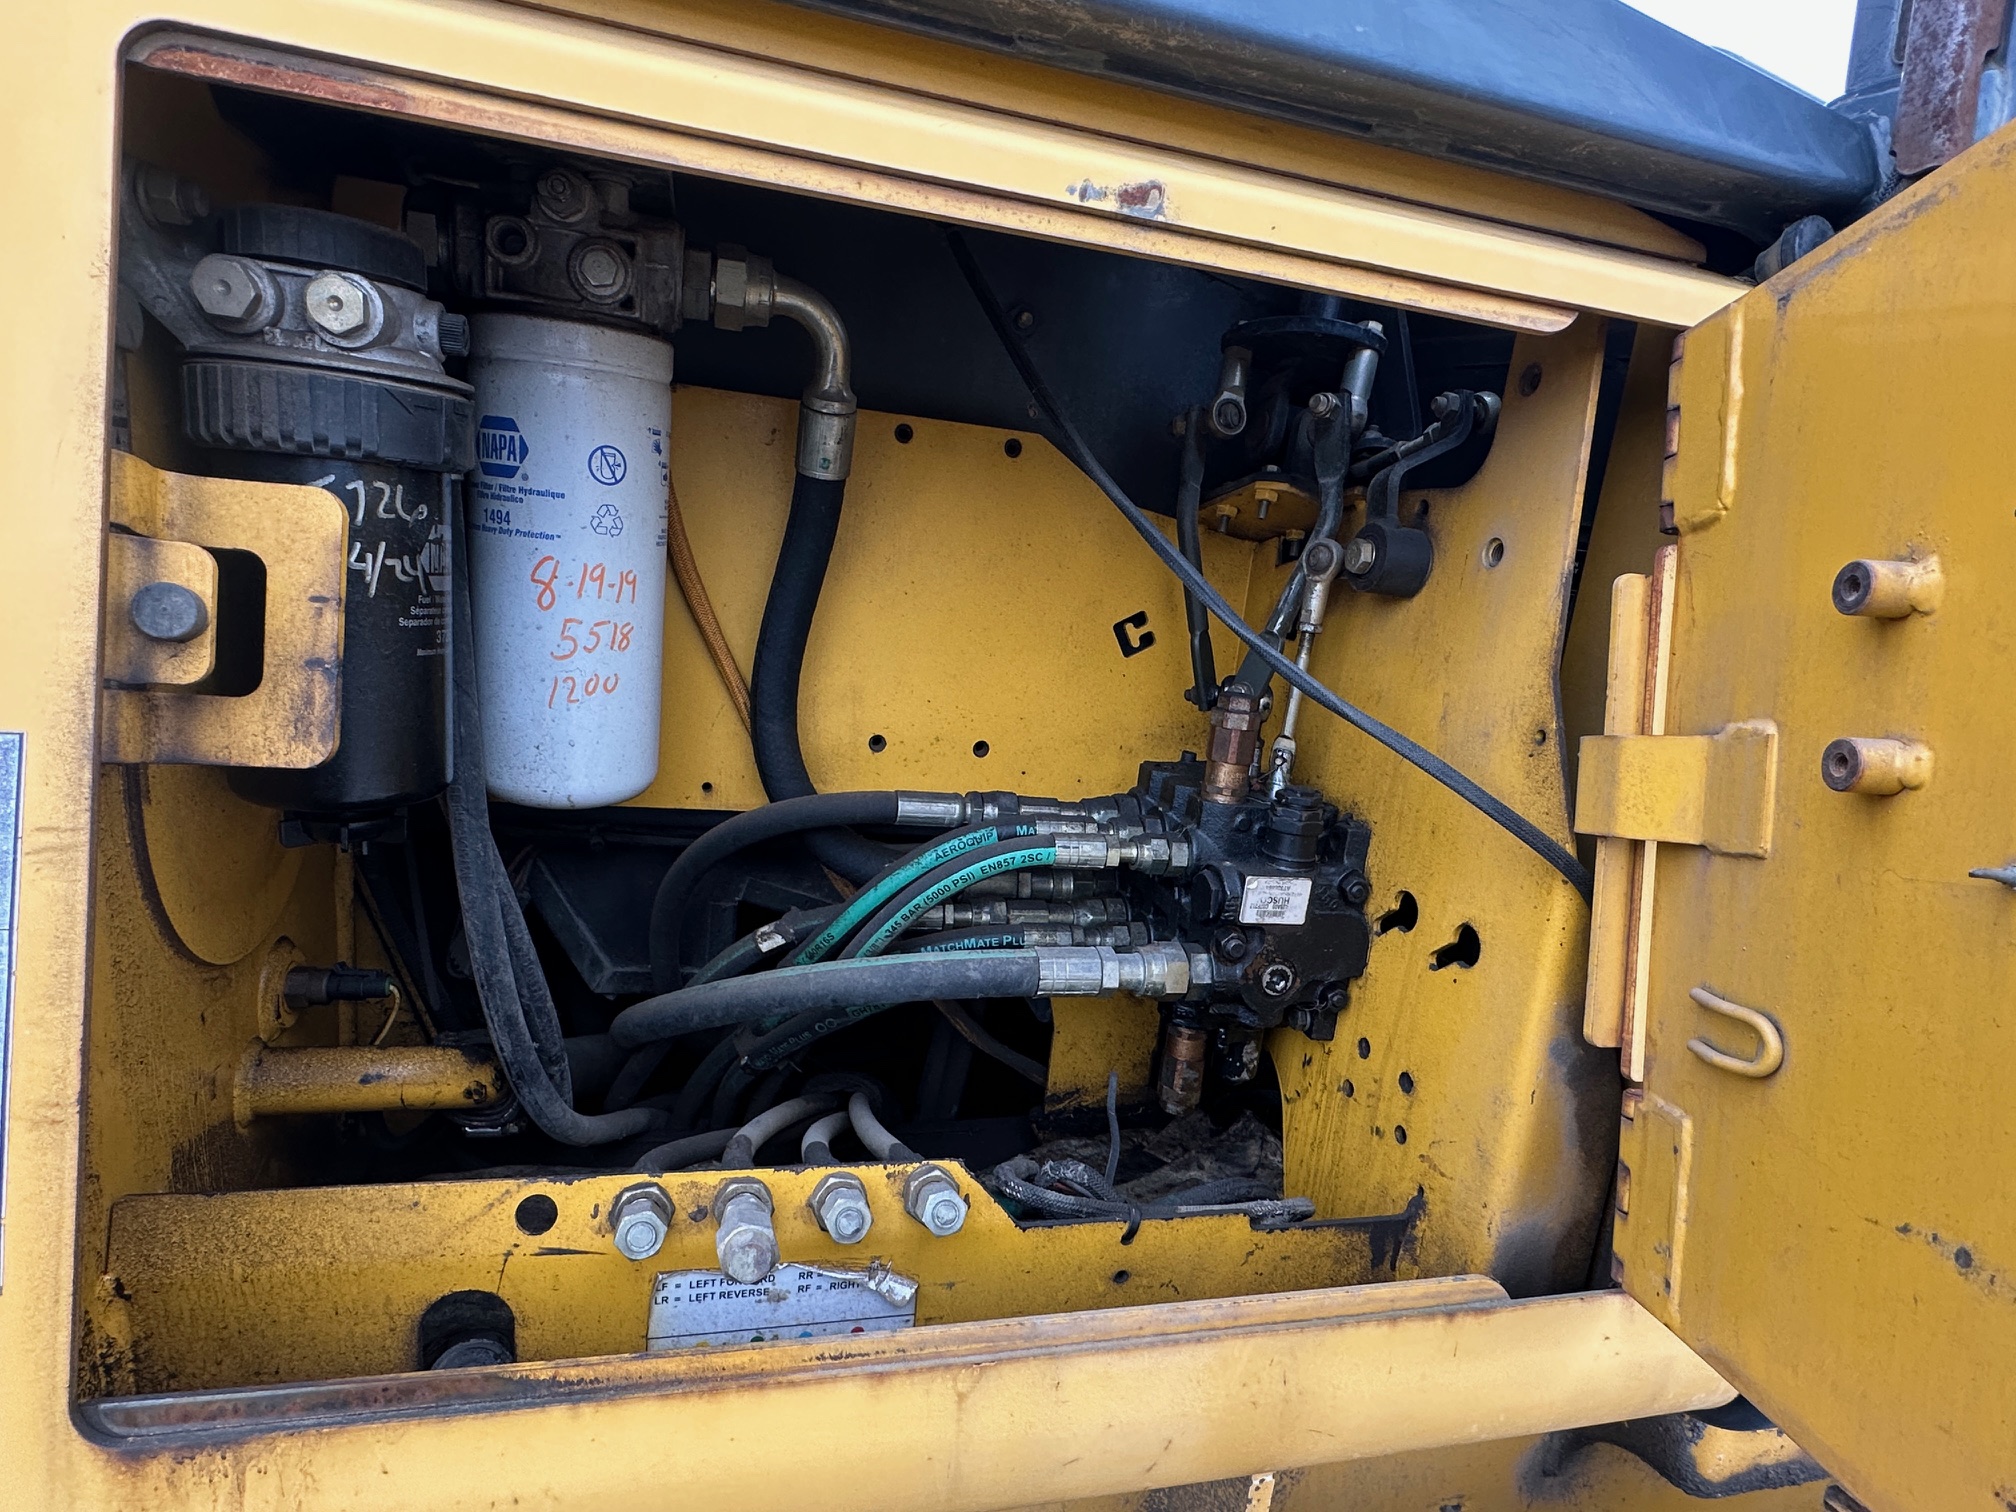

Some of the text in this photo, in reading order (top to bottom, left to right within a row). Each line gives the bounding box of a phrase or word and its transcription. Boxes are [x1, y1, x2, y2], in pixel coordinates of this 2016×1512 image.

[481, 431, 517, 462] NAPA
[308, 474, 428, 527] 726
[498, 483, 517, 494] Filtre
[518, 485, 566, 500] Hydraulique
[483, 507, 511, 526] 1494
[498, 525, 514, 538] Duty
[398, 616, 434, 629] Separador
[550, 617, 634, 662] 5518
[548, 672, 619, 709] 1200
[934, 830, 994, 862] AEROQUIP
[900, 901, 923, 923] BAR
[923, 884, 952, 908] (5000
[951, 870, 977, 891] PSI)
[979, 856, 1016, 876] EN857
[1020, 850, 1044, 864] 2SC
[1002, 934, 1025, 947] PLU
[688, 1278, 719, 1291] LEFT
[798, 1271, 814, 1281] RR
[654, 1295, 669, 1305] LR
[688, 1291, 718, 1304] LEFT
[718, 1287, 770, 1300] REVERSE
[797, 1284, 812, 1293] RF
